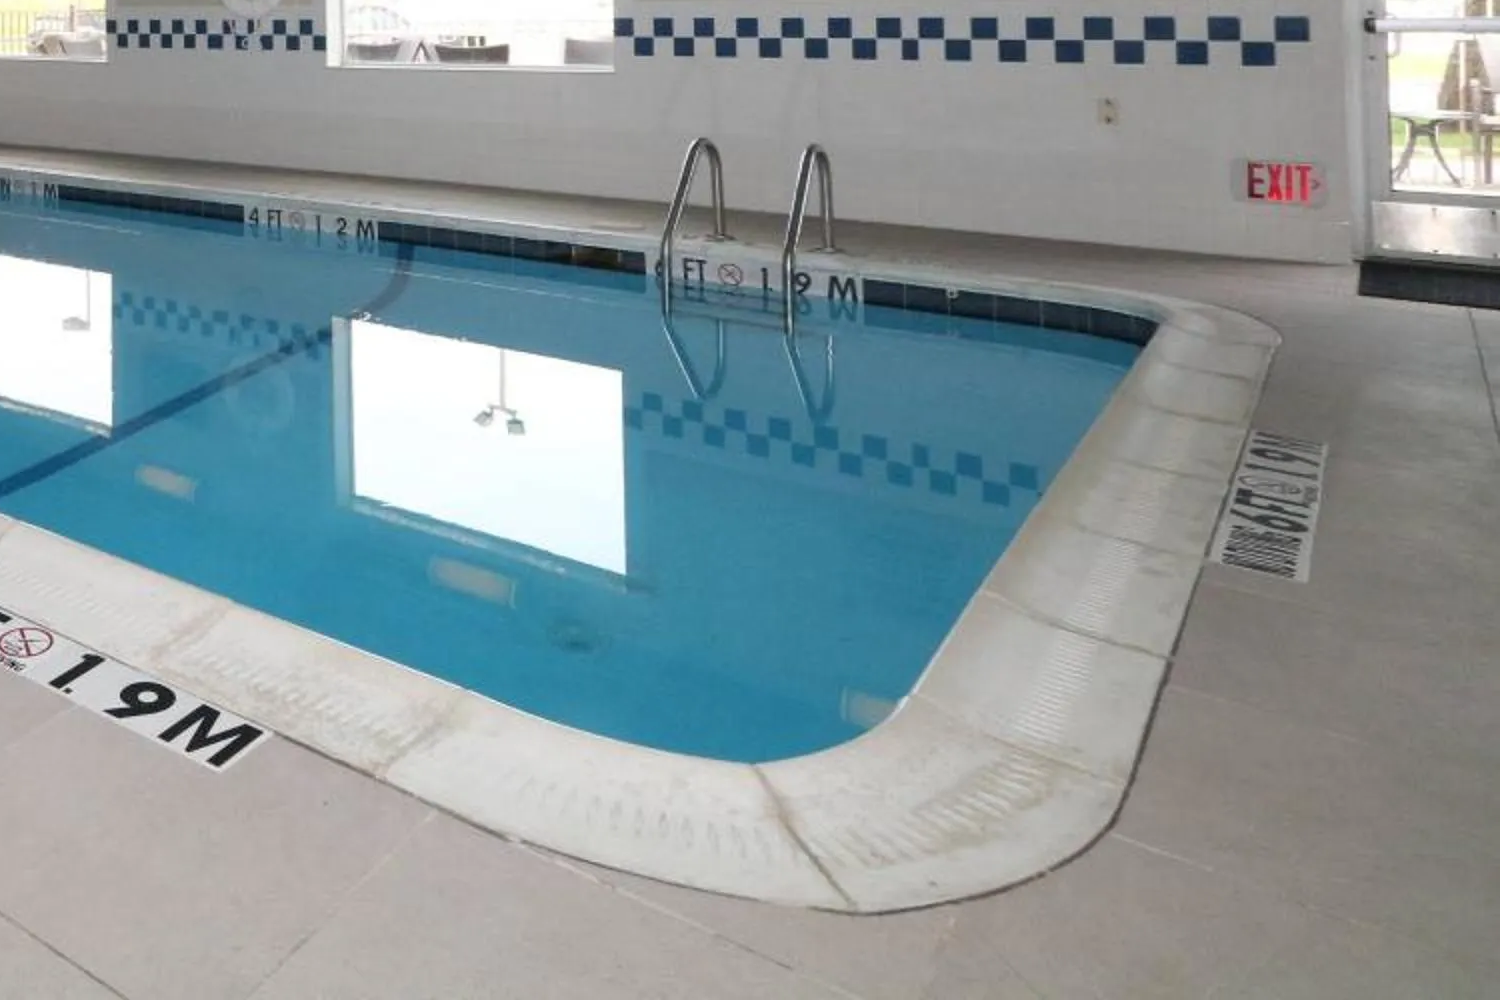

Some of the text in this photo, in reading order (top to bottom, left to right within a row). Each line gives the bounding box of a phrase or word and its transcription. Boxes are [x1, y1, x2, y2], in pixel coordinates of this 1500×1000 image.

[1247, 162, 1312, 201] EXIT
[249, 206, 259, 224] 4
[267, 209, 282, 229] FT
[356, 219, 375, 240] M
[683, 257, 707, 281] FT
[828, 275, 858, 303] M
[1229, 507, 1309, 532] 6
[157, 704, 264, 769] M
